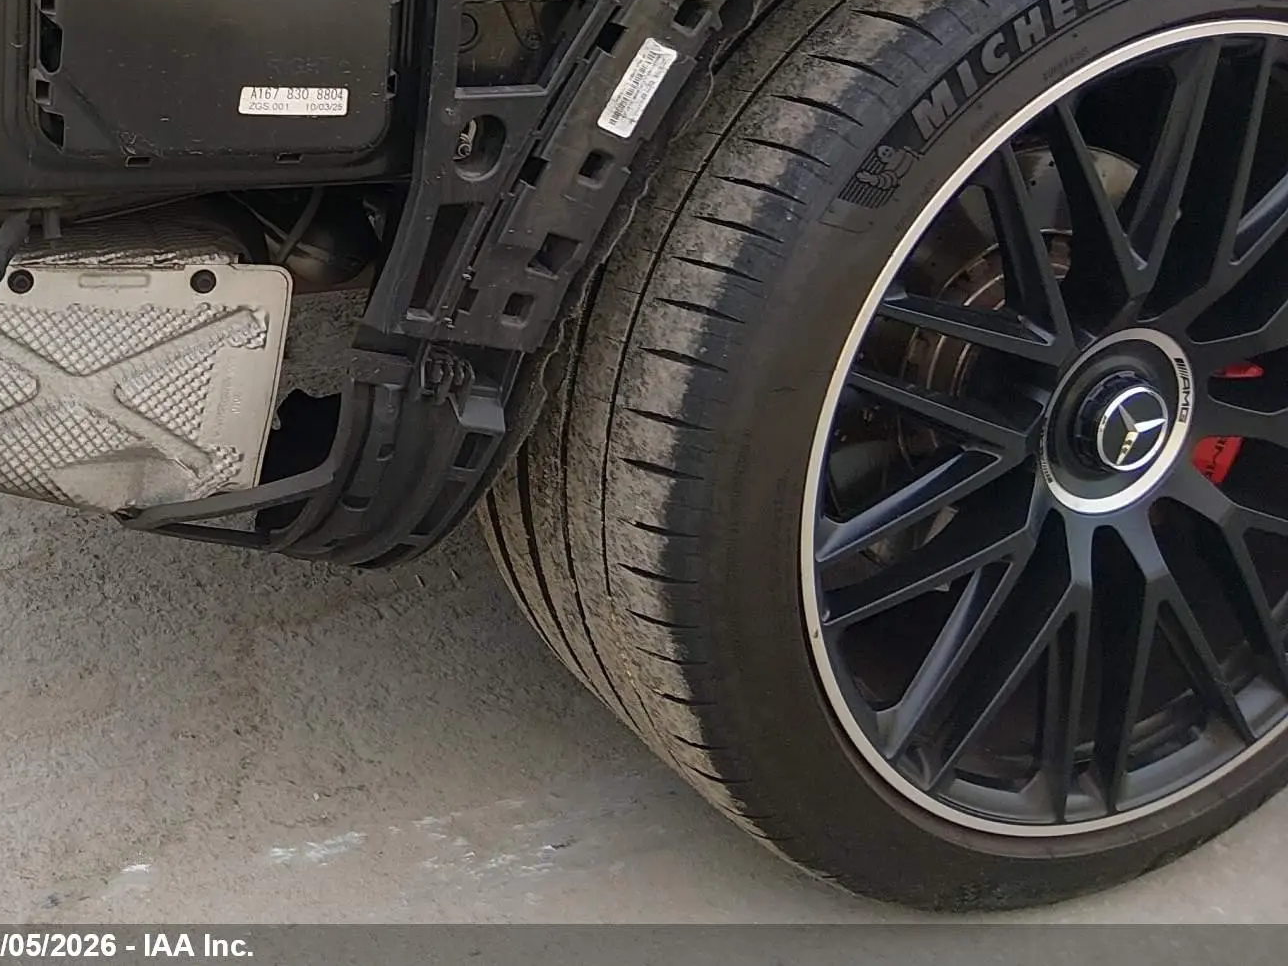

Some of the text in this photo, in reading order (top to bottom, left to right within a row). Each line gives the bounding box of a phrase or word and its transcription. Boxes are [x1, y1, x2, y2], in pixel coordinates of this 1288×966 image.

[250, 88, 344, 101] A167 830 8804
[1177, 375, 1192, 423] AMG
